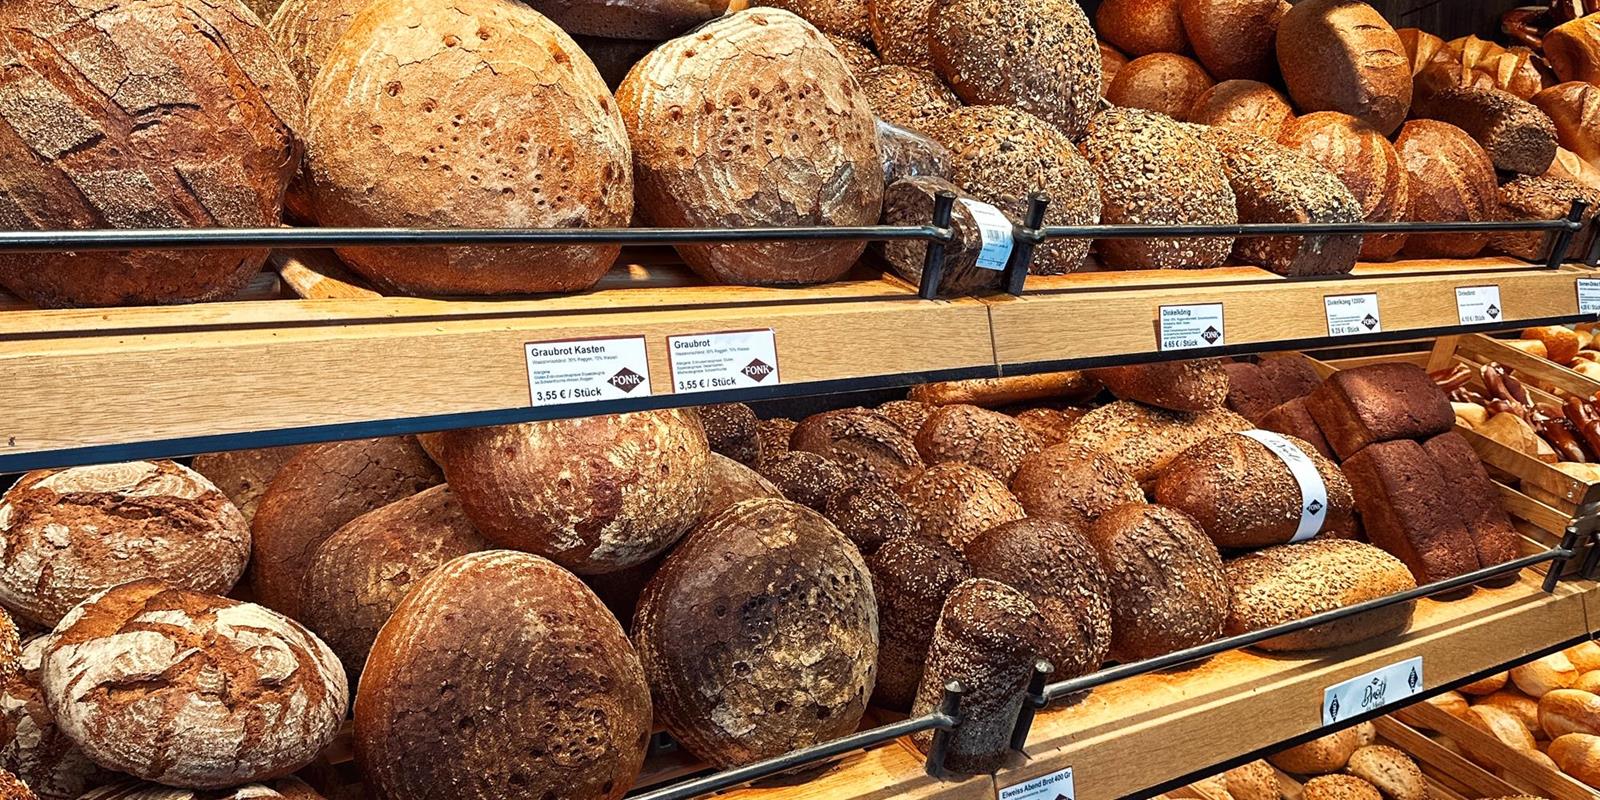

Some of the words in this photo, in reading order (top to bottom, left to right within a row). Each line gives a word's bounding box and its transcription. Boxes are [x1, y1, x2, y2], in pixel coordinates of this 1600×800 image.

[1204, 331, 1219, 339] FONK
[674, 339, 711, 349] Graubrot
[1183, 339, 1198, 347] Stück
[531, 347, 572, 357] Graubrot
[575, 345, 606, 355] Kasten
[744, 365, 770, 376] FONK
[612, 374, 641, 386] FONK
[679, 380, 698, 391] 3,55
[699, 379, 705, 388] €
[712, 377, 737, 387] Stück
[537, 391, 557, 402] 3,55
[560, 389, 566, 398] €
[574, 387, 602, 398] Stück
[1002, 787, 1024, 799] Eiweiss
[1024, 780, 1042, 792] Abend
[1042, 777, 1054, 786] Brot
[1054, 773, 1064, 782] 400
[1064, 771, 1071, 779] Gr
